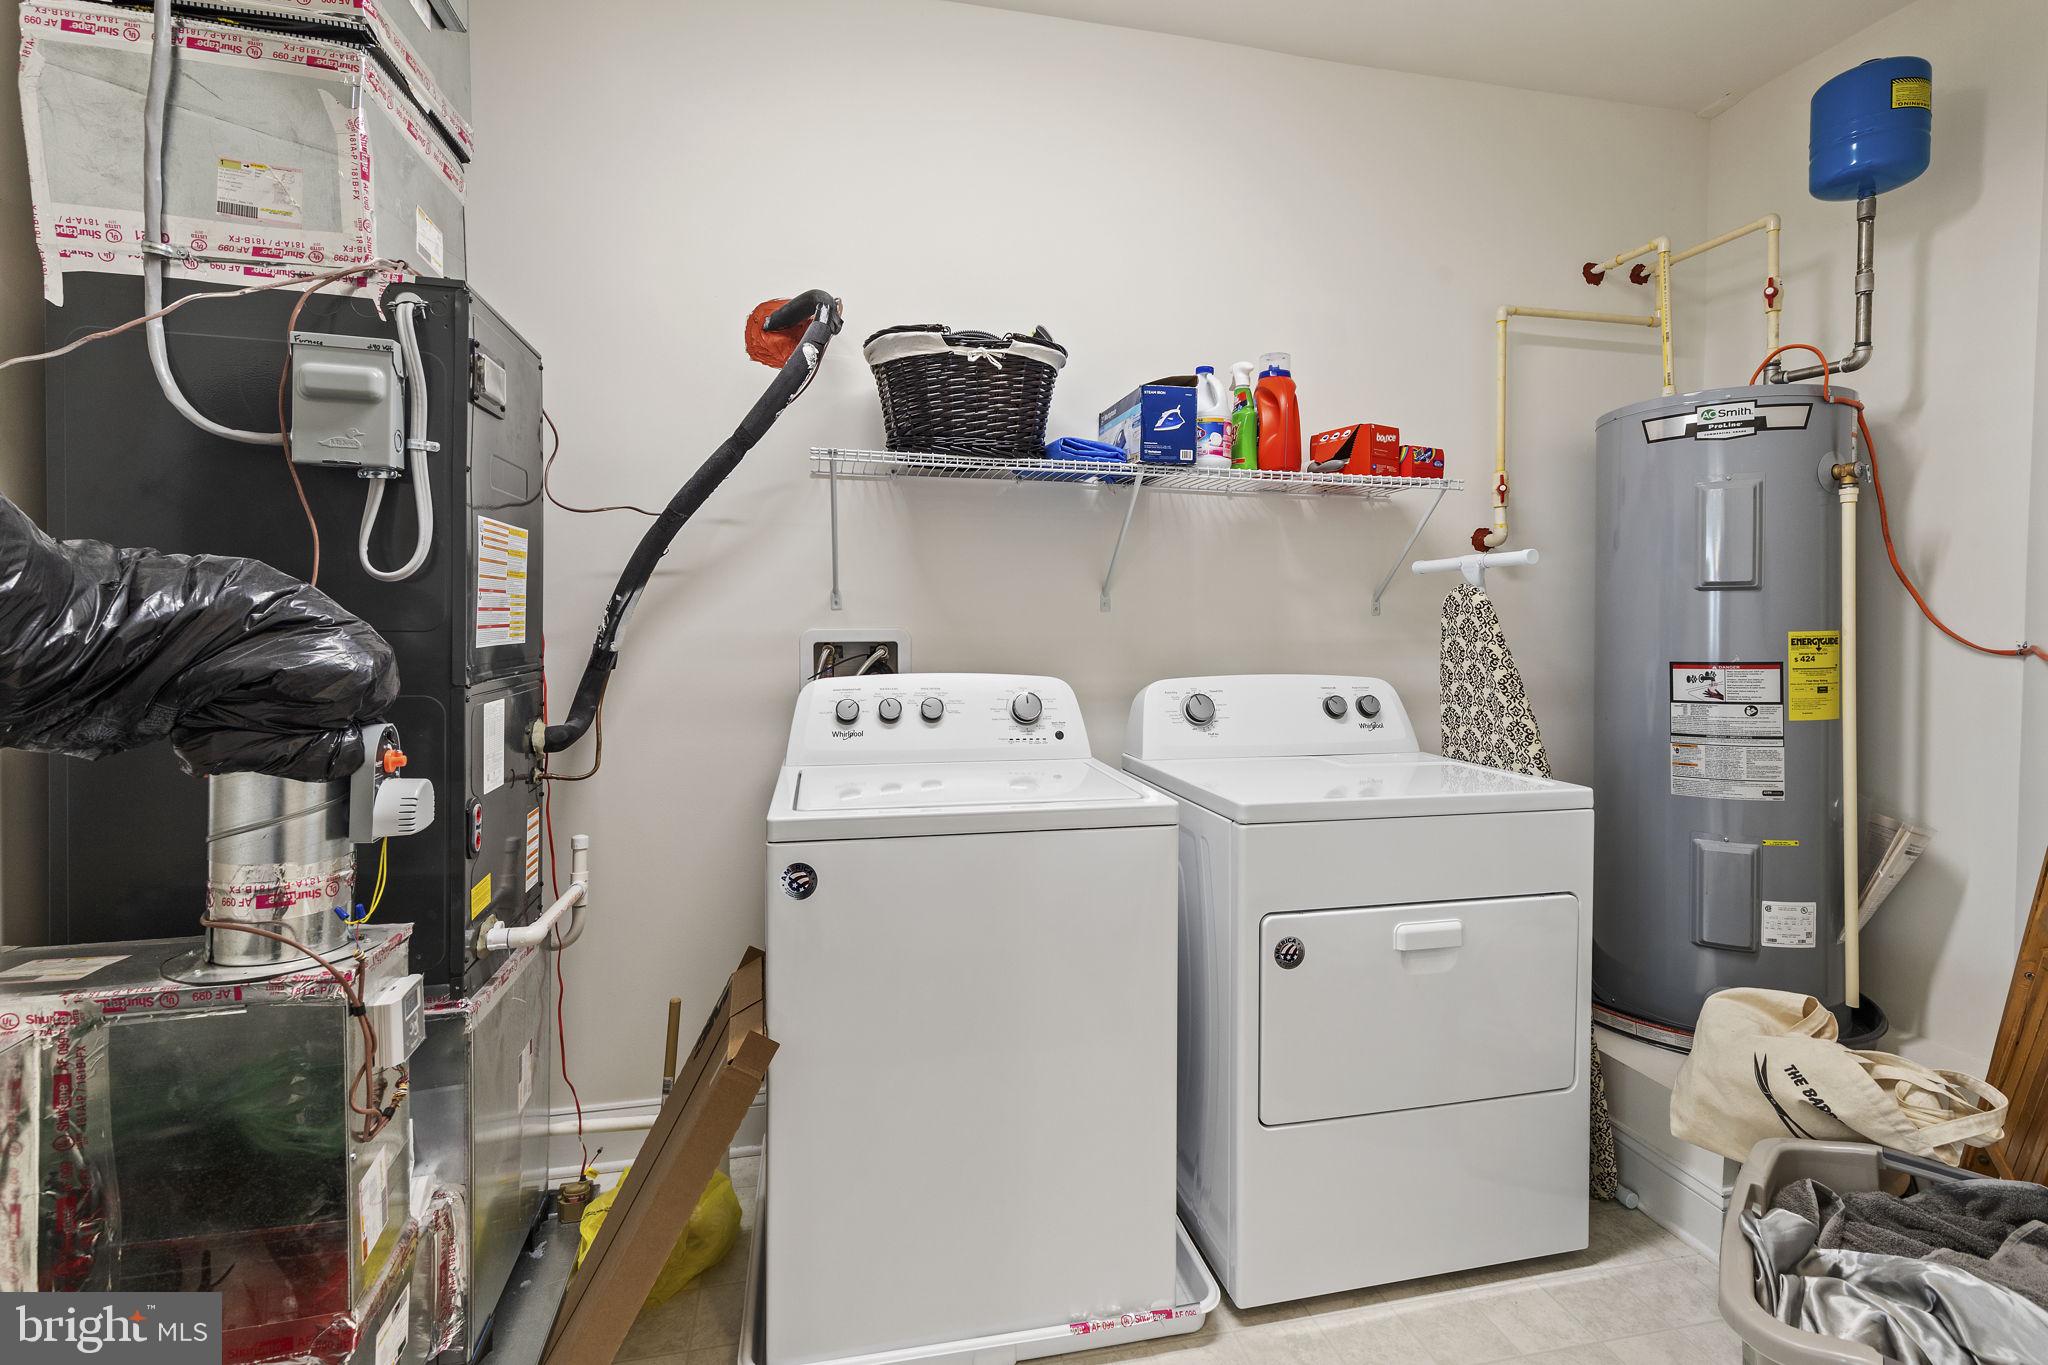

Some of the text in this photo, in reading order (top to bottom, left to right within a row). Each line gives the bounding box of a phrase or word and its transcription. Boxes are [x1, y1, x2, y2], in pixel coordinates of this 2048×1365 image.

[86, 15, 118, 24] 181A-P
[24, 15, 119, 36] Shurtape AF 099
[212, 32, 242, 43] 181A-P
[197, 41, 242, 54] Shurtape
[273, 51, 289, 60] 099
[317, 56, 360, 73] Shurtape
[66, 217, 99, 226] 181A-P
[229, 235, 266, 244] 181B-FX
[218, 244, 234, 252] 099
[274, 241, 305, 249] 181A-P
[260, 247, 305, 259] Shurtape
[1718, 407, 1751, 418] Smith
[1708, 421, 1741, 430] ProLine
[1376, 433, 1397, 443] bounce
[832, 729, 864, 740] Whirlpool
[222, 897, 236, 907] 099
[239, 898, 252, 907] AF
[192, 989, 231, 1001] AF 099
[58, 1037, 70, 1055] 099
[1784, 1064, 1809, 1087] THE
